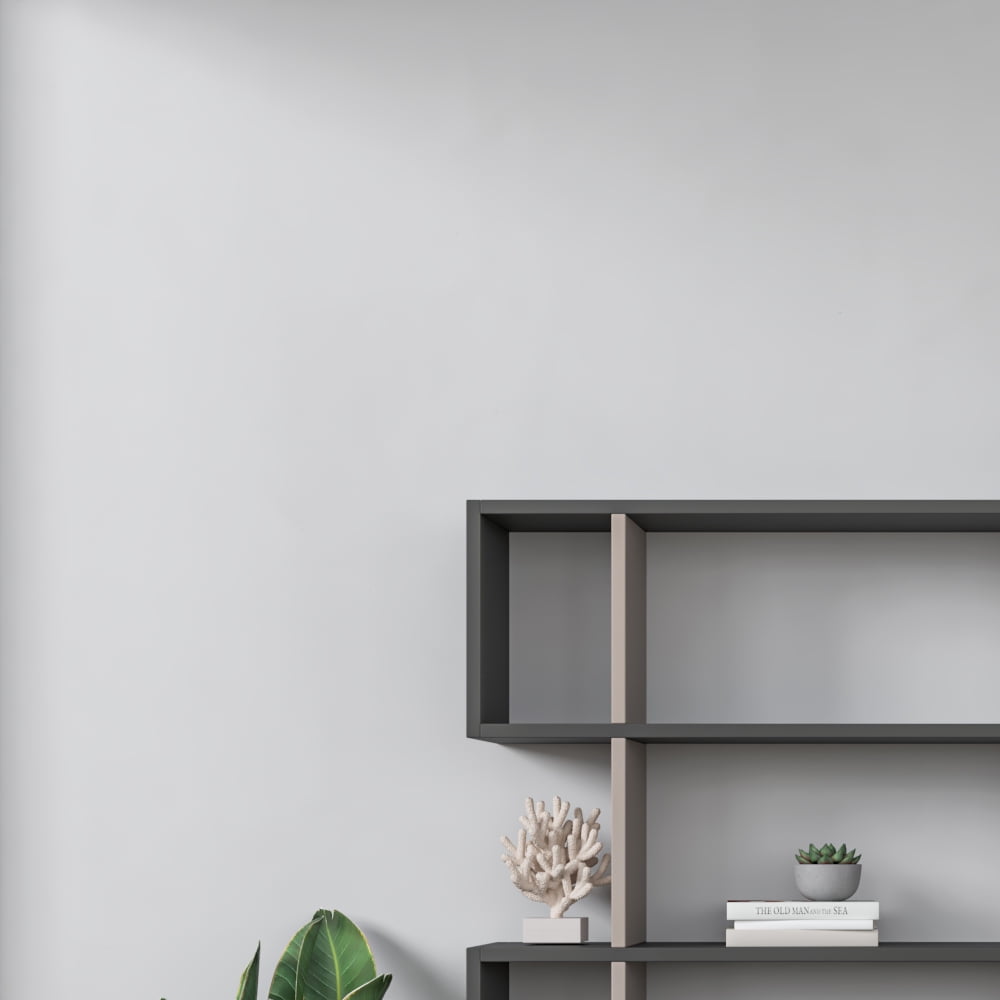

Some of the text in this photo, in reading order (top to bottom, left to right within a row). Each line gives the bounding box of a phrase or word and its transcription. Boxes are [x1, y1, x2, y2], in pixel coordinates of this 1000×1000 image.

[756, 906, 772, 915] THE
[773, 906, 791, 915] OLD
[792, 906, 810, 915] MAN
[833, 906, 848, 915] SEA
